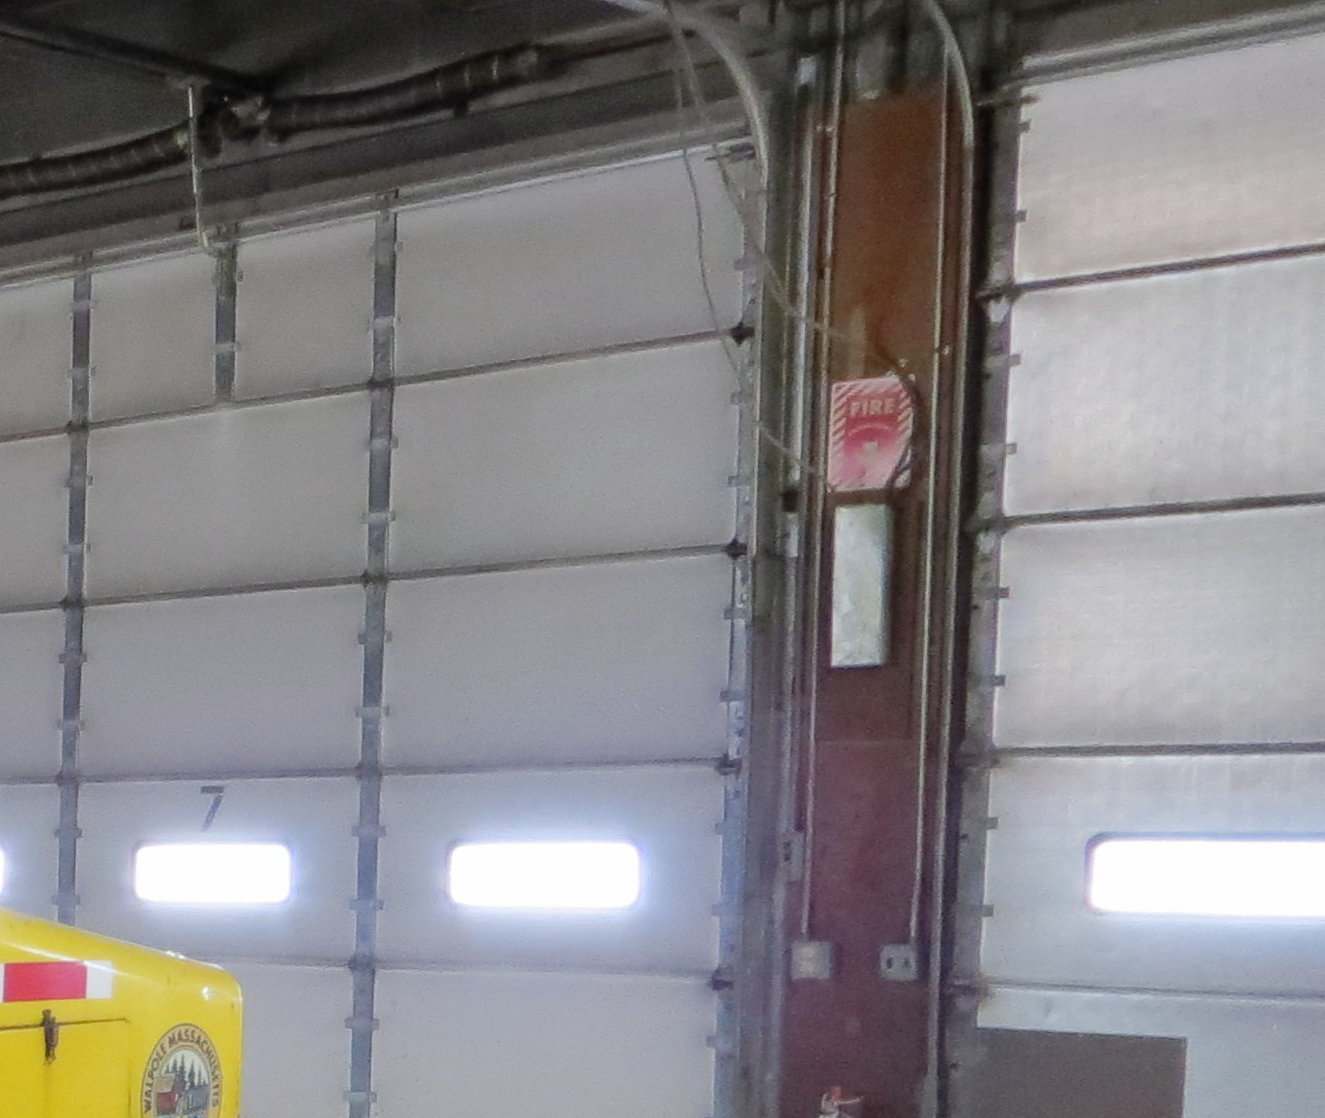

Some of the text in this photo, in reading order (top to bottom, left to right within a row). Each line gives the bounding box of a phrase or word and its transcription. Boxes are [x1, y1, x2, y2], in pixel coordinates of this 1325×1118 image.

[850, 398, 896, 417] FIRE
[200, 785, 225, 832] 7
[144, 1044, 168, 1114] WALPOLE
